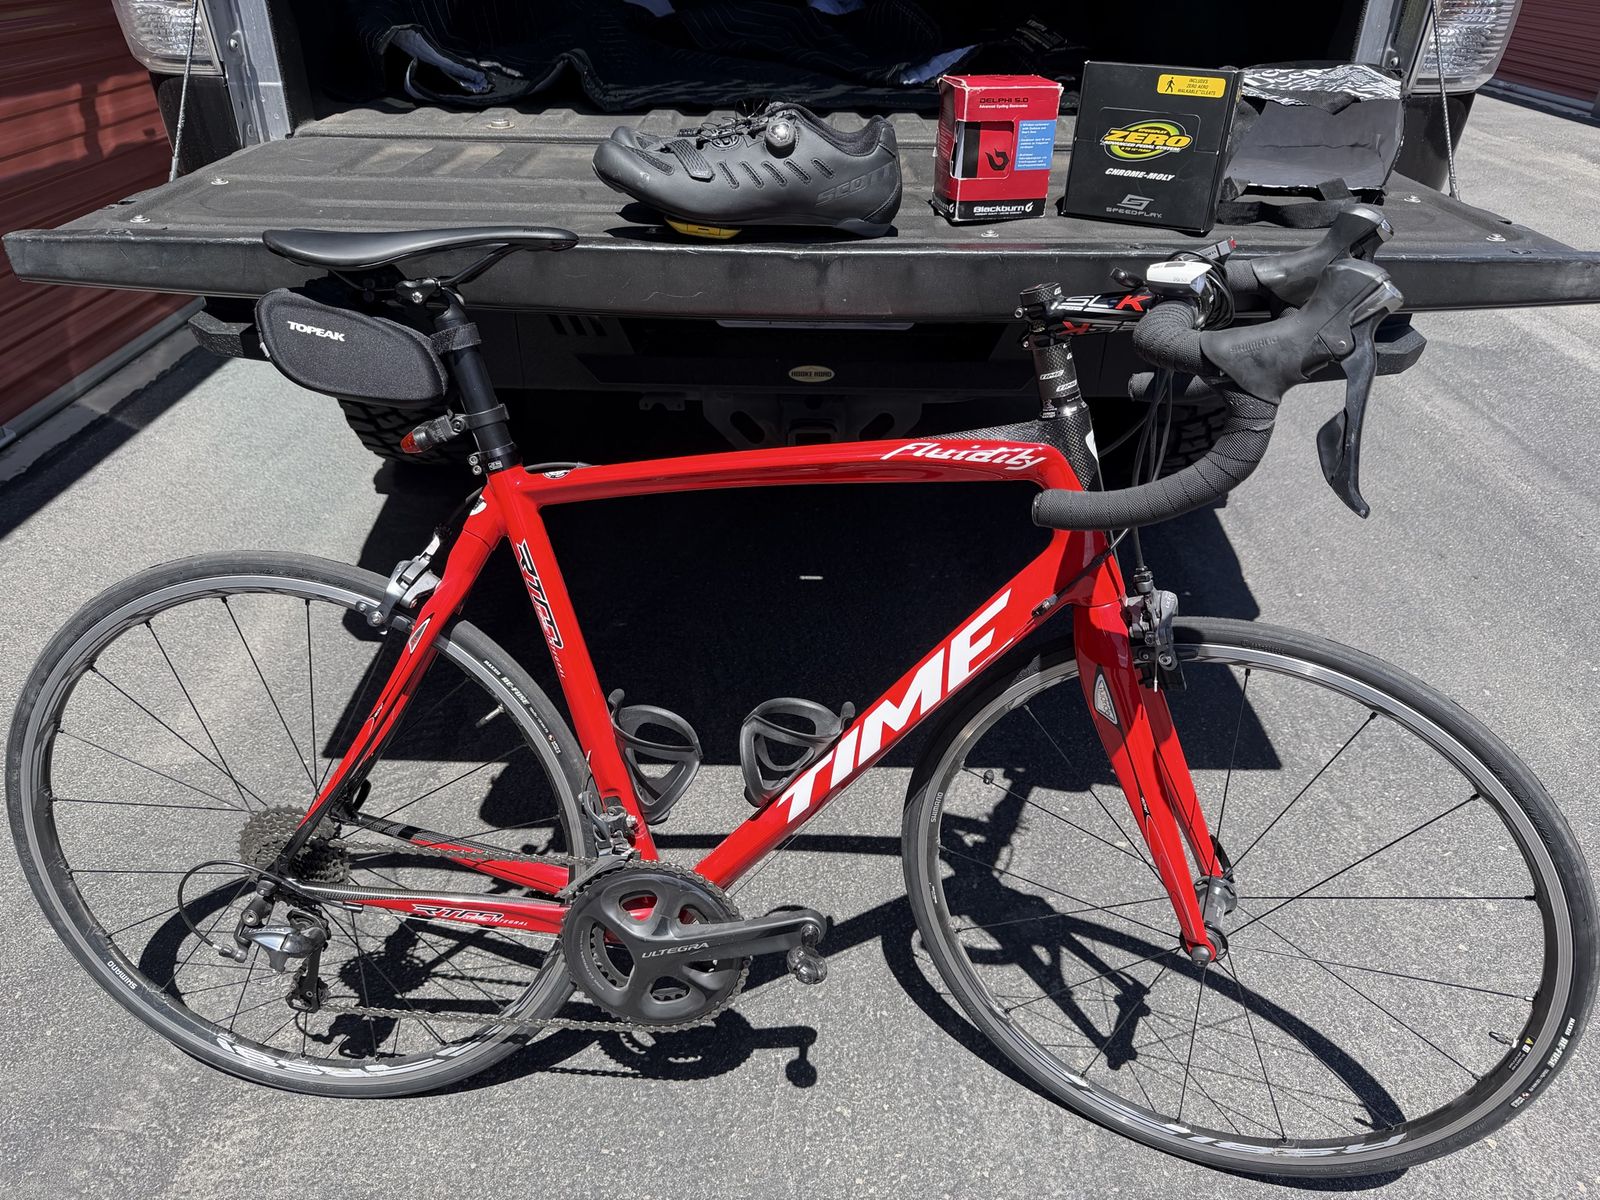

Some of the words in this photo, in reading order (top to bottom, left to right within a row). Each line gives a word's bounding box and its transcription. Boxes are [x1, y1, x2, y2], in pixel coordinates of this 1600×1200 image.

[1103, 129, 1191, 148] ZERO
[815, 163, 894, 207] SCOTT
[1105, 167, 1176, 182] CHROME-MOLY
[973, 204, 1024, 213] Blackburn
[1106, 206, 1163, 218] SPEEDPLAY
[287, 320, 346, 342] TOPEAK
[880, 442, 1047, 471] Fluidity
[483, 659, 502, 676] MAXXIS
[501, 676, 531, 706] RE-FUSE
[776, 587, 1015, 824] TIME
[930, 791, 944, 823] SHIMANO
[641, 942, 710, 959] ULTEGRA
[106, 960, 138, 990] SHIMANO
[1564, 1017, 1576, 1036] MAXXIS
[1547, 1036, 1569, 1069] RE-FUSE
